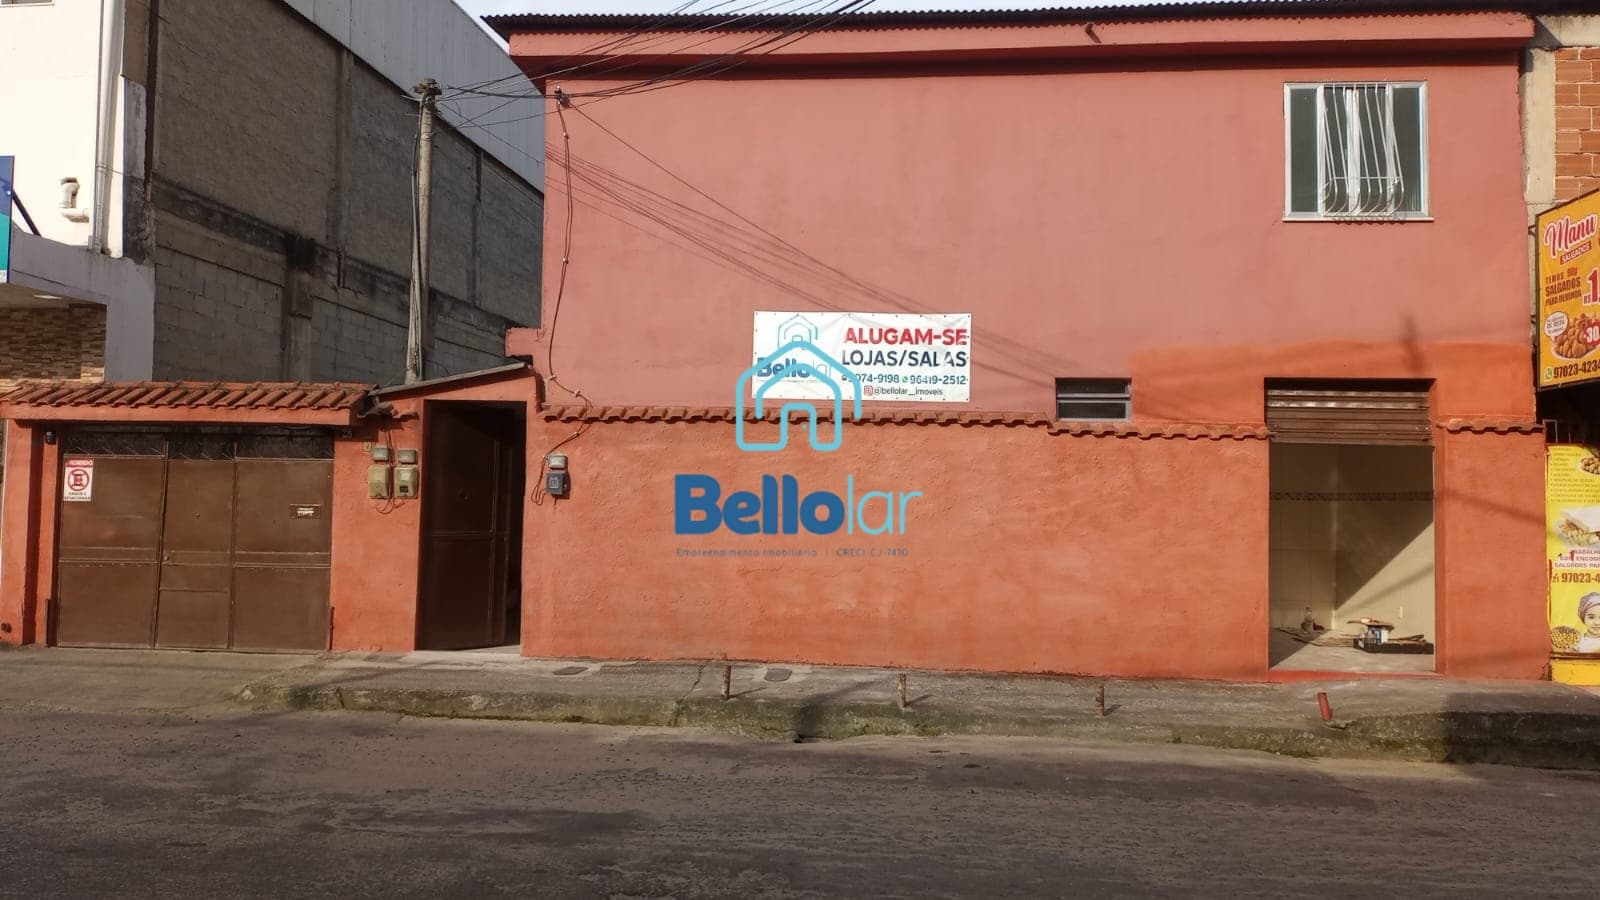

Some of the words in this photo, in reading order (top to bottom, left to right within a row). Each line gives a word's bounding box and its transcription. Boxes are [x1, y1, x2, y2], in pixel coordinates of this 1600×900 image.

[1545, 215, 1595, 257] Manu
[1561, 243, 1591, 263] SALGADOS
[1546, 277, 1581, 297] SALGADOS
[845, 328, 967, 345] ALUGAM-SE
[842, 350, 967, 367] LOJAS/SALAS
[910, 375, 967, 385] 96419-2512
